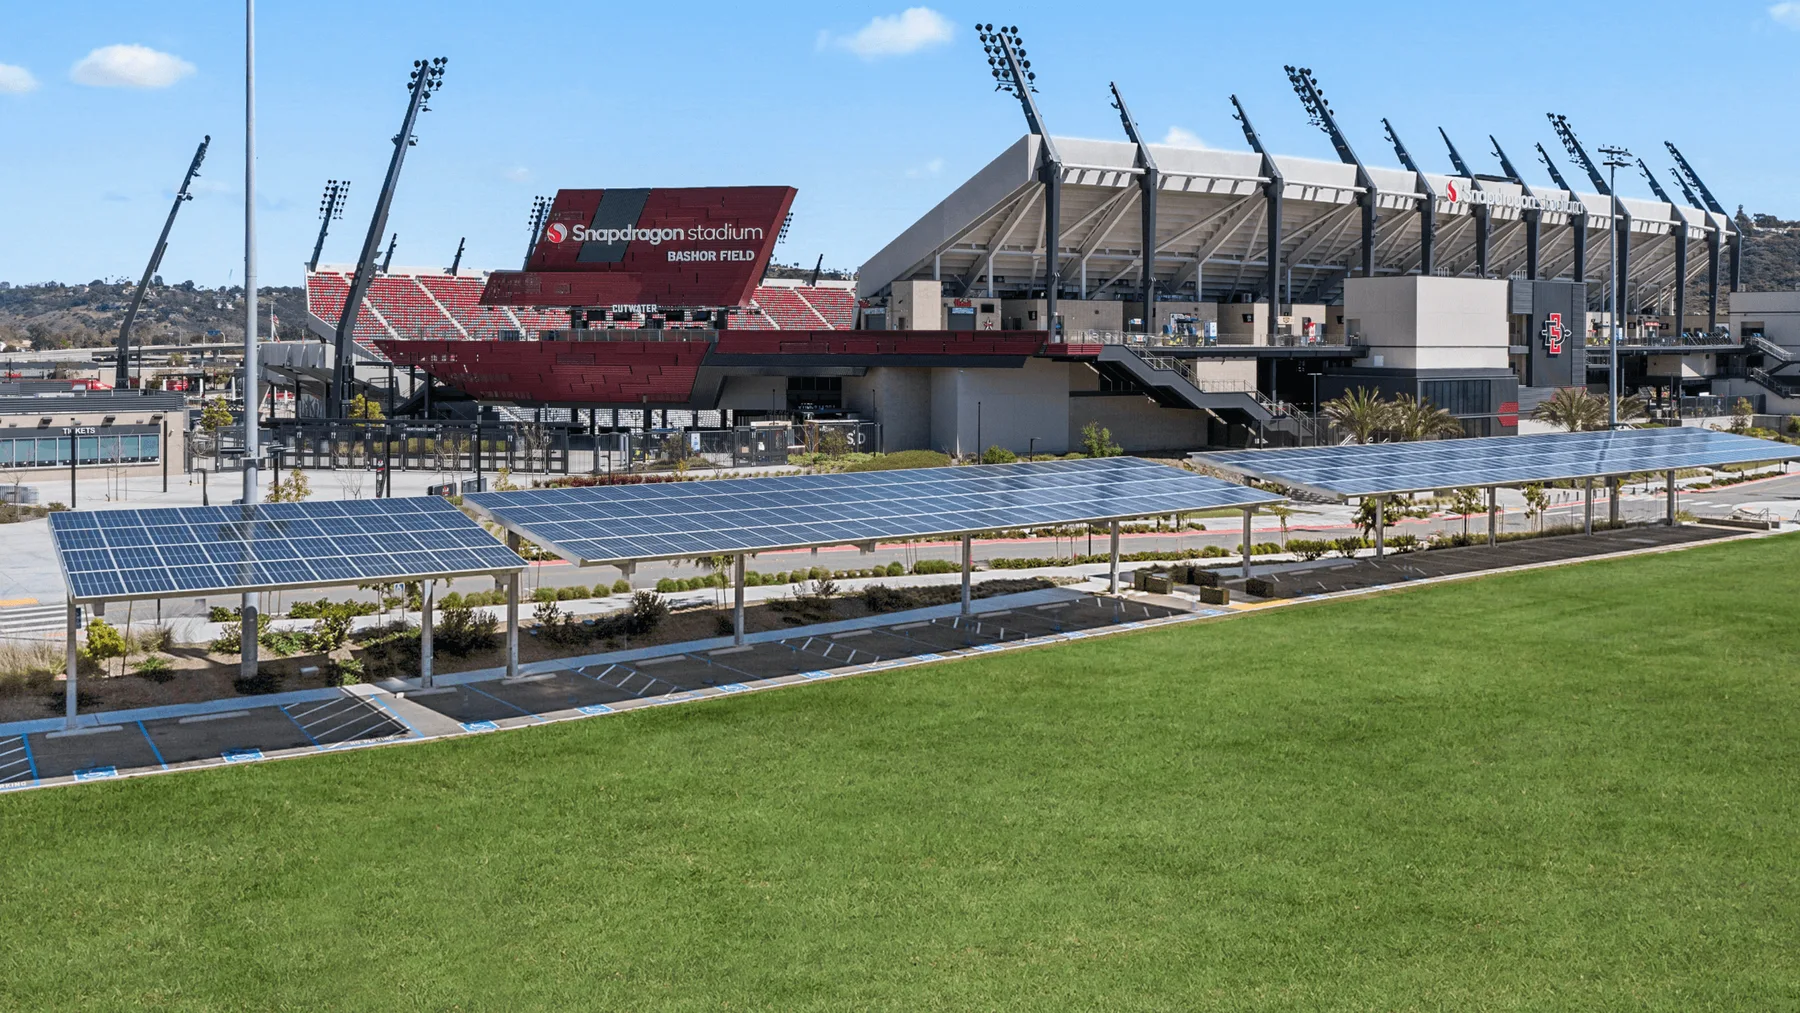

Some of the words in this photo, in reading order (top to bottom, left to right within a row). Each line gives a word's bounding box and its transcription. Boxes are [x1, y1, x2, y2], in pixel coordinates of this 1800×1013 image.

[572, 223, 685, 246] Snapdragon
[687, 222, 764, 241] stadium
[667, 250, 717, 262] BASHOR
[719, 250, 755, 262] FIELD
[611, 303, 658, 313] CUTWATER
